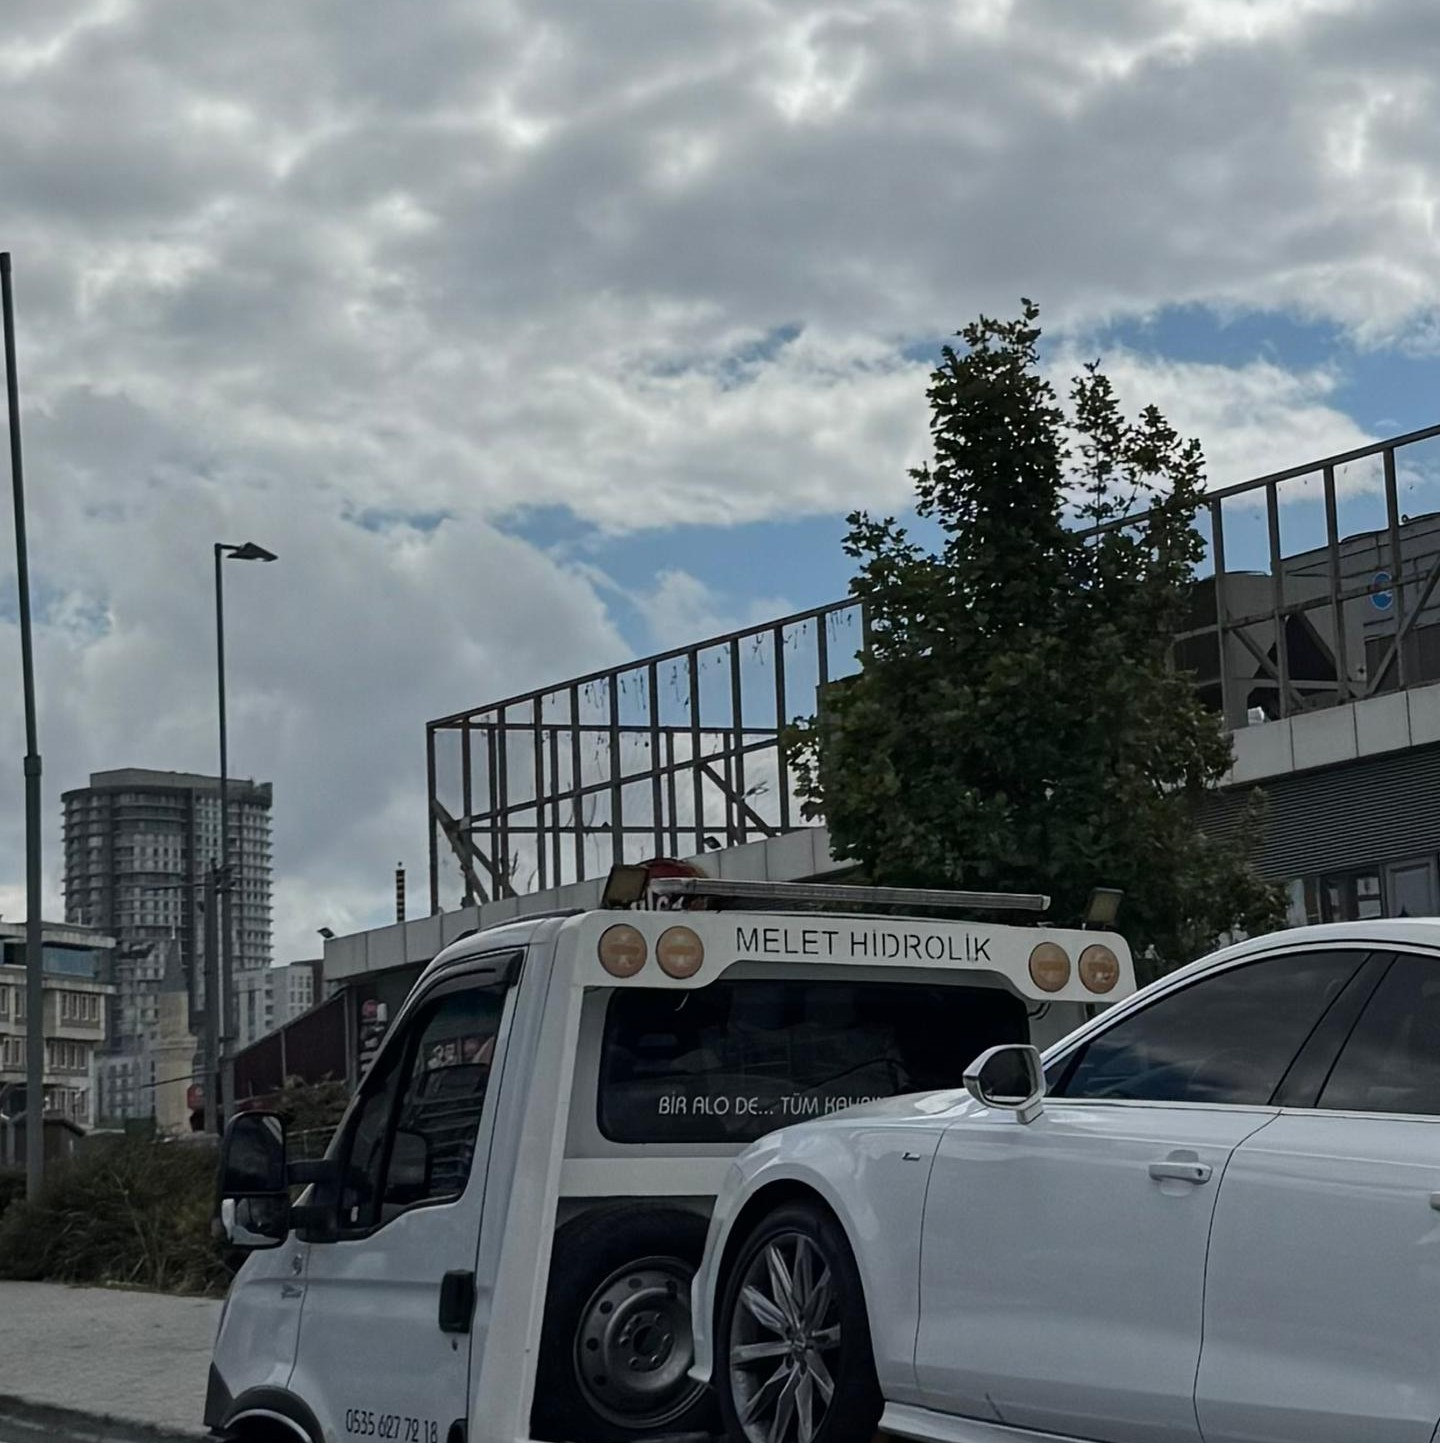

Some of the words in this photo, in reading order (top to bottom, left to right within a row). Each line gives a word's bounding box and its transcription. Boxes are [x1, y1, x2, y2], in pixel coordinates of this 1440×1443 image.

[736, 927, 839, 955] MELET
[658, 1091, 686, 1115] BİR
[692, 1096, 729, 1115] ALO
[780, 1092, 819, 1115] TÜM
[345, 1408, 375, 1436] 0535
[377, 1414, 401, 1439] 627
[403, 1417, 420, 1443] 72
